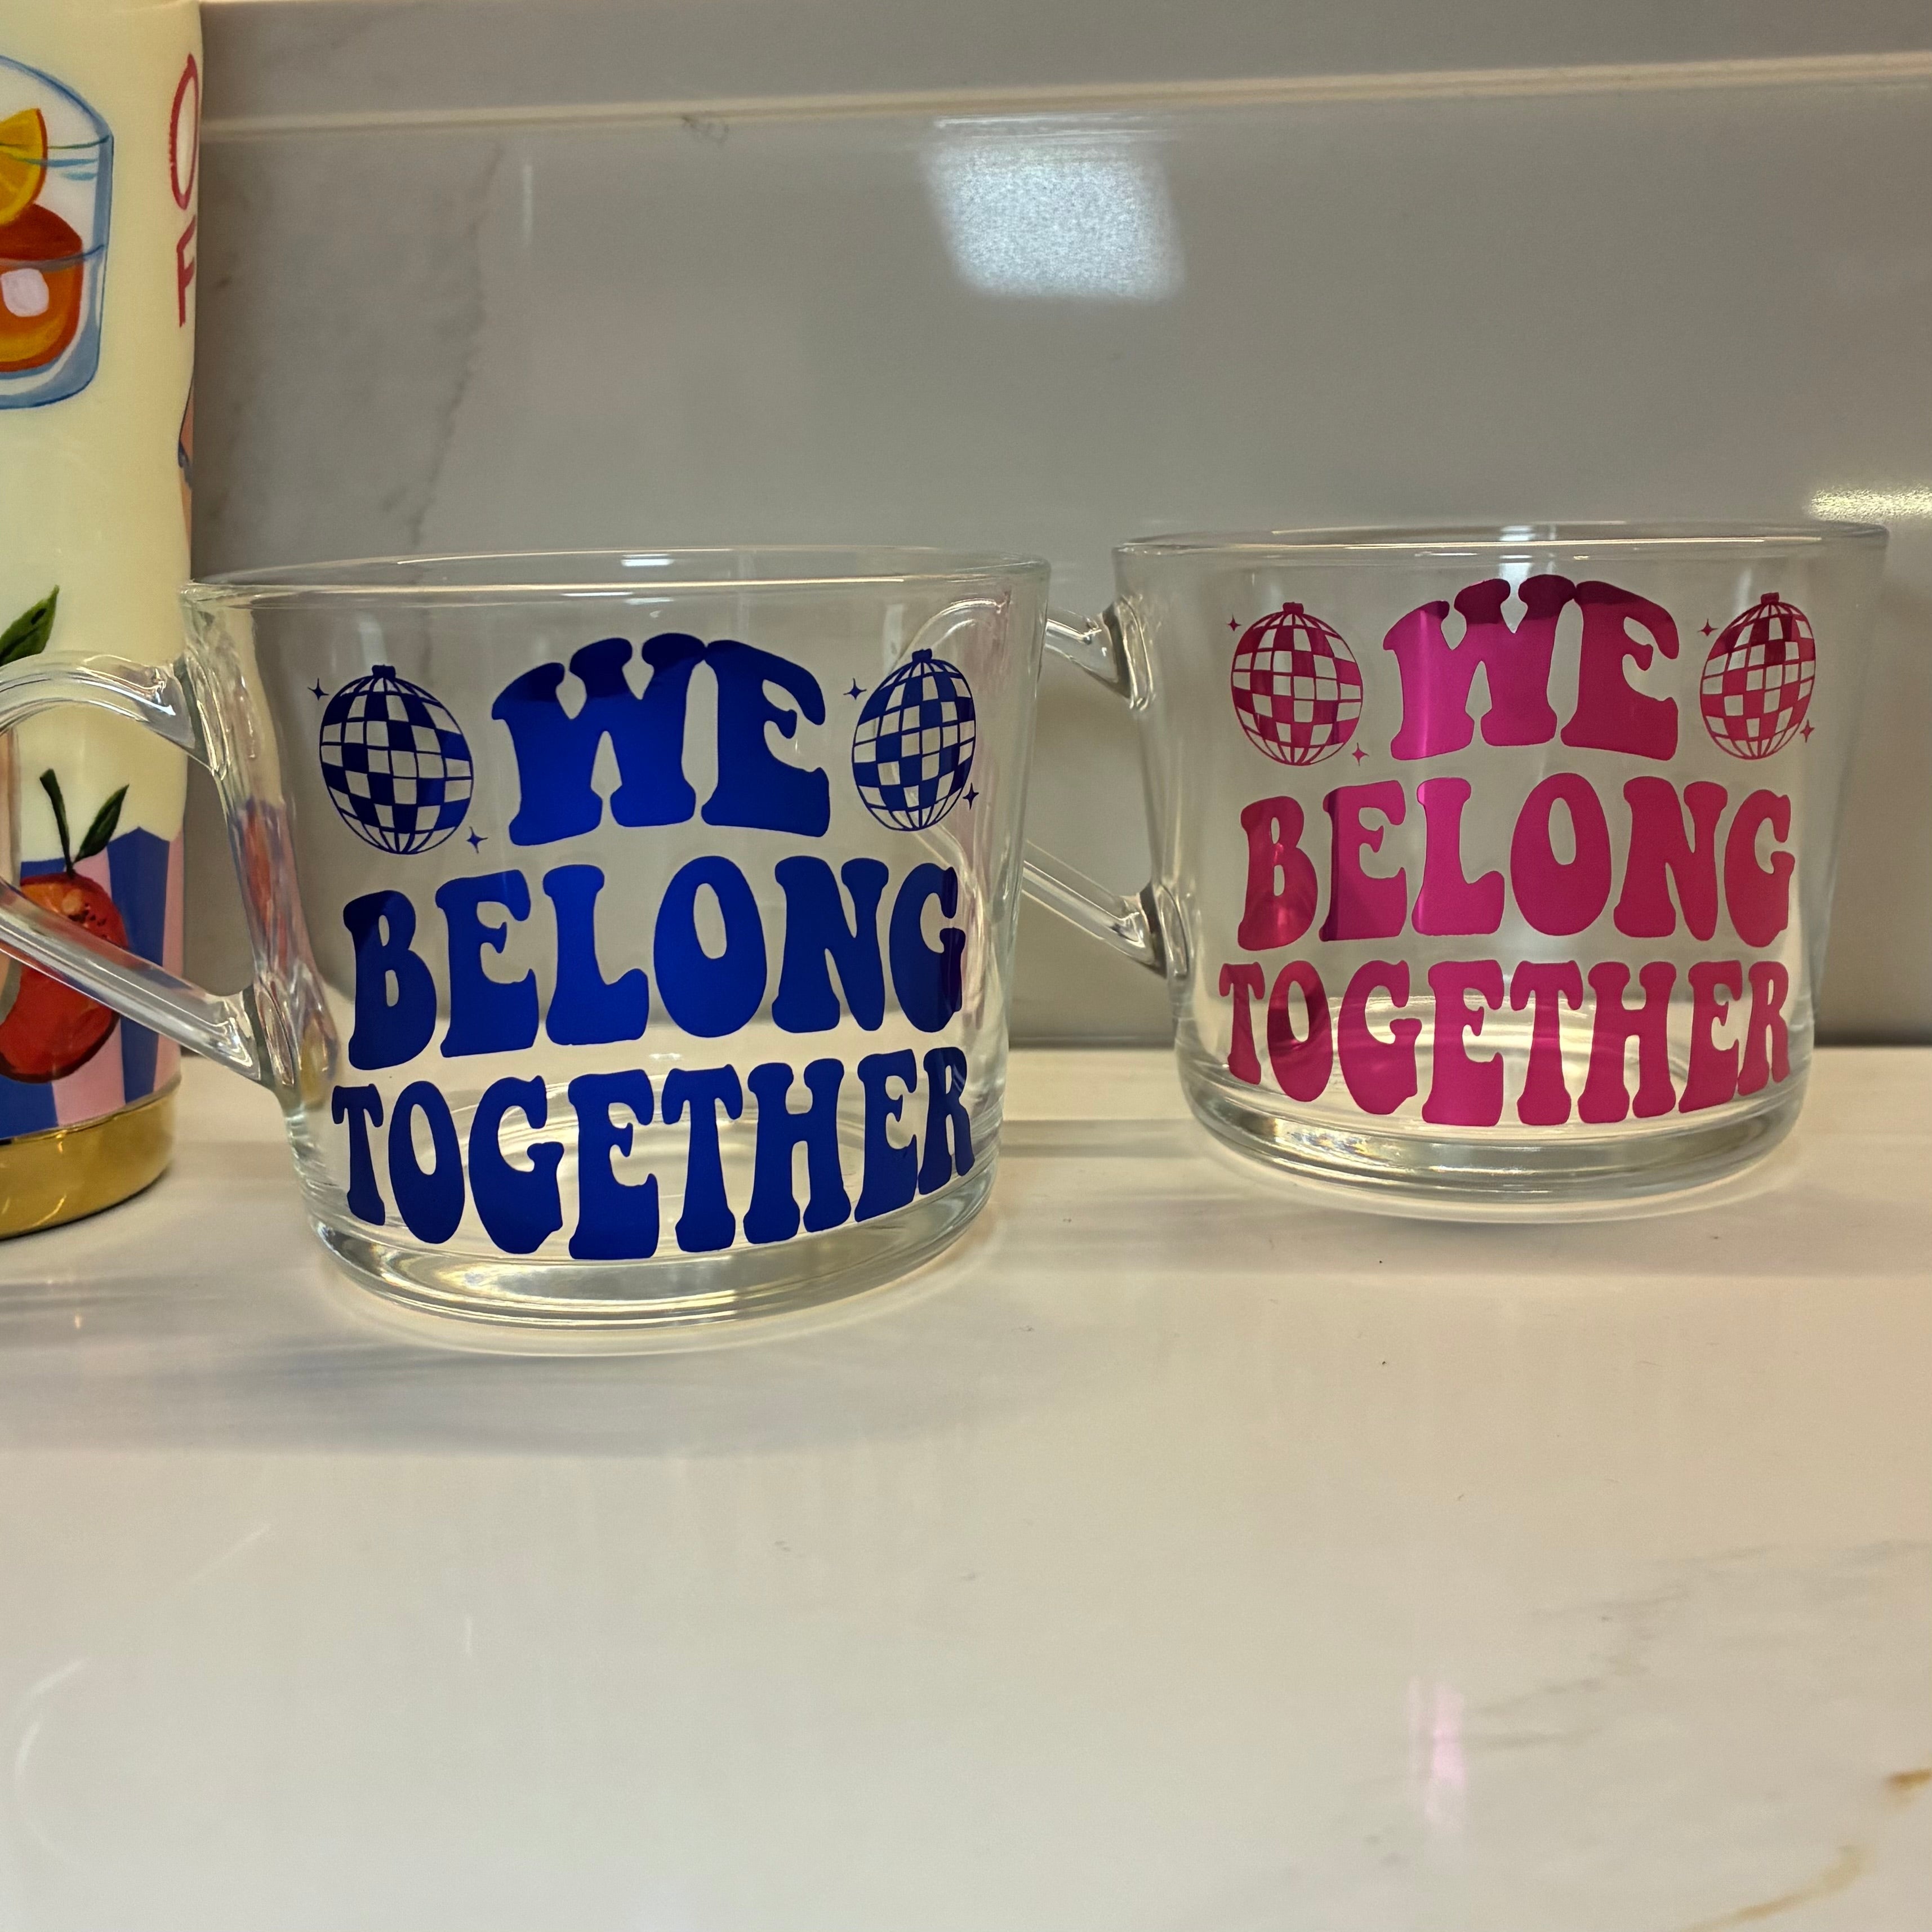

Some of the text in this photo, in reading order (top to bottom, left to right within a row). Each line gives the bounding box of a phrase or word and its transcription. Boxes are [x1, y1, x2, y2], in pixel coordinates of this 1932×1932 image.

[491, 633, 830, 847] WE
[1383, 574, 1679, 762] WE
[1237, 772, 1796, 952] BELONG
[342, 855, 967, 1071] BELONG
[1218, 959, 1791, 1128] TOGETHER
[331, 1046, 977, 1260] TOGETHER
